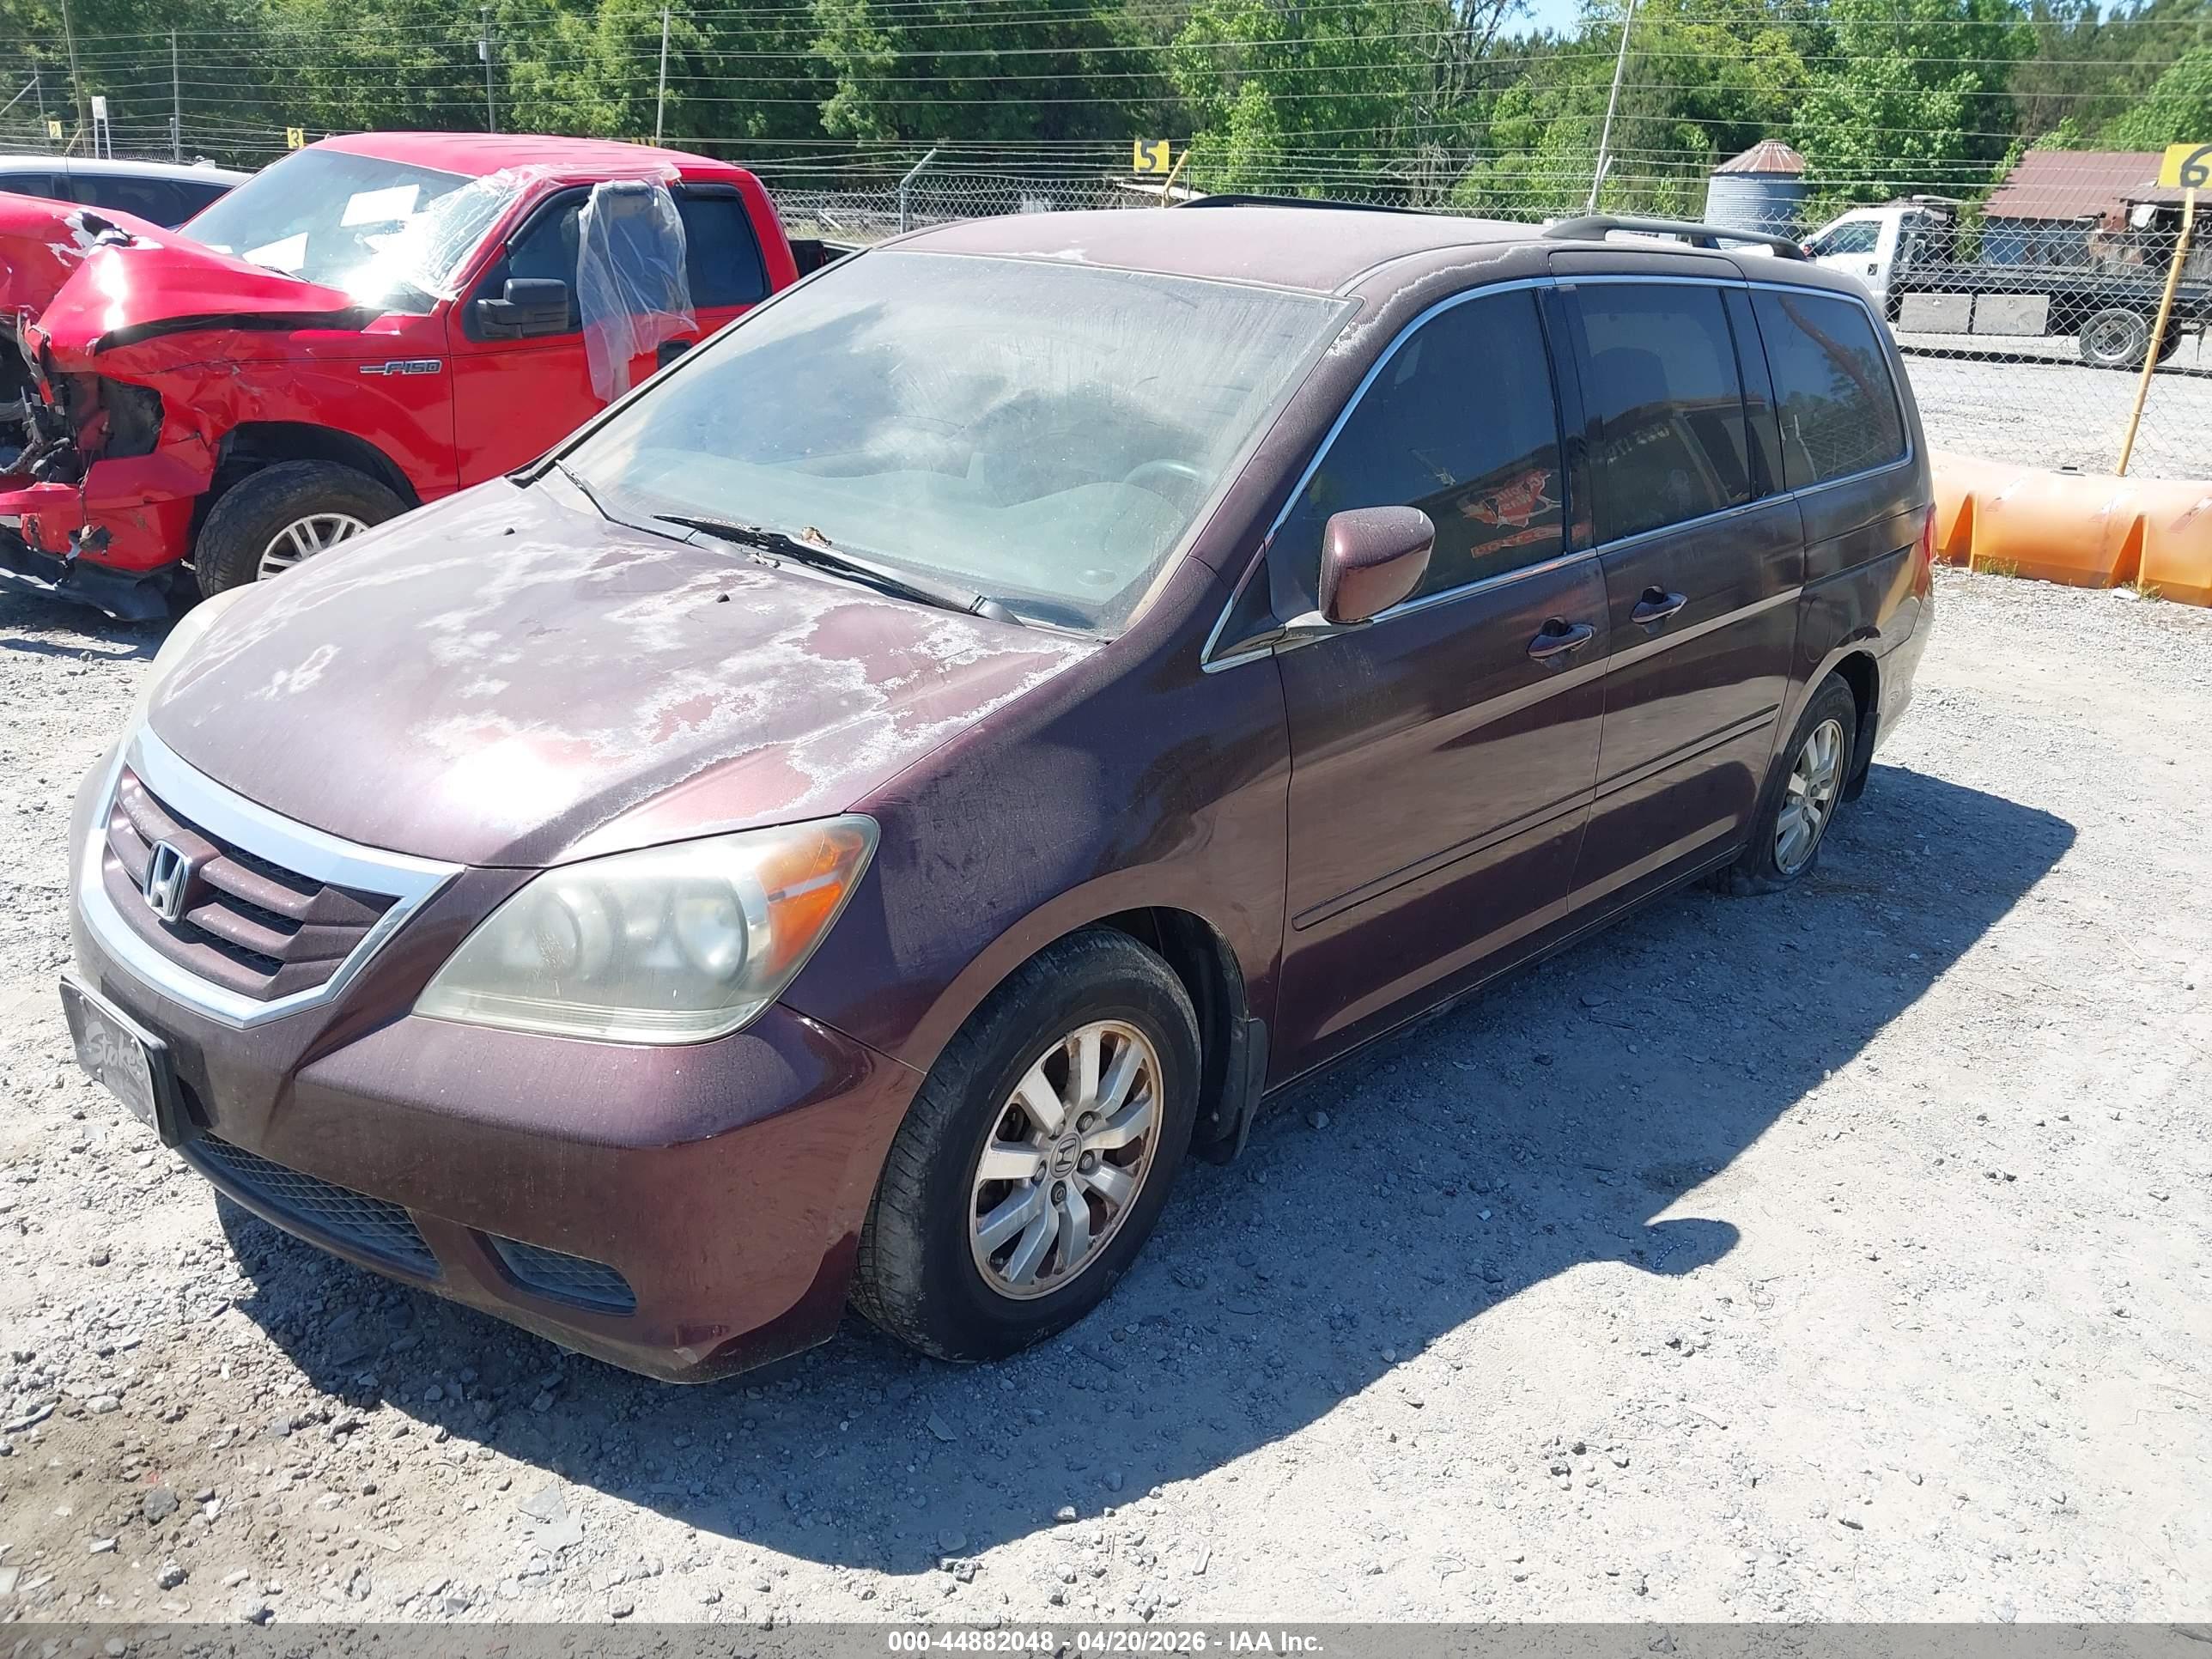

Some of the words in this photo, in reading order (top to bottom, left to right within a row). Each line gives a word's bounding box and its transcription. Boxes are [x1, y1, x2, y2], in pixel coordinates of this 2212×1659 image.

[290, 129, 301, 149] 3
[1140, 138, 1159, 173] 5
[2179, 145, 2212, 187] 6
